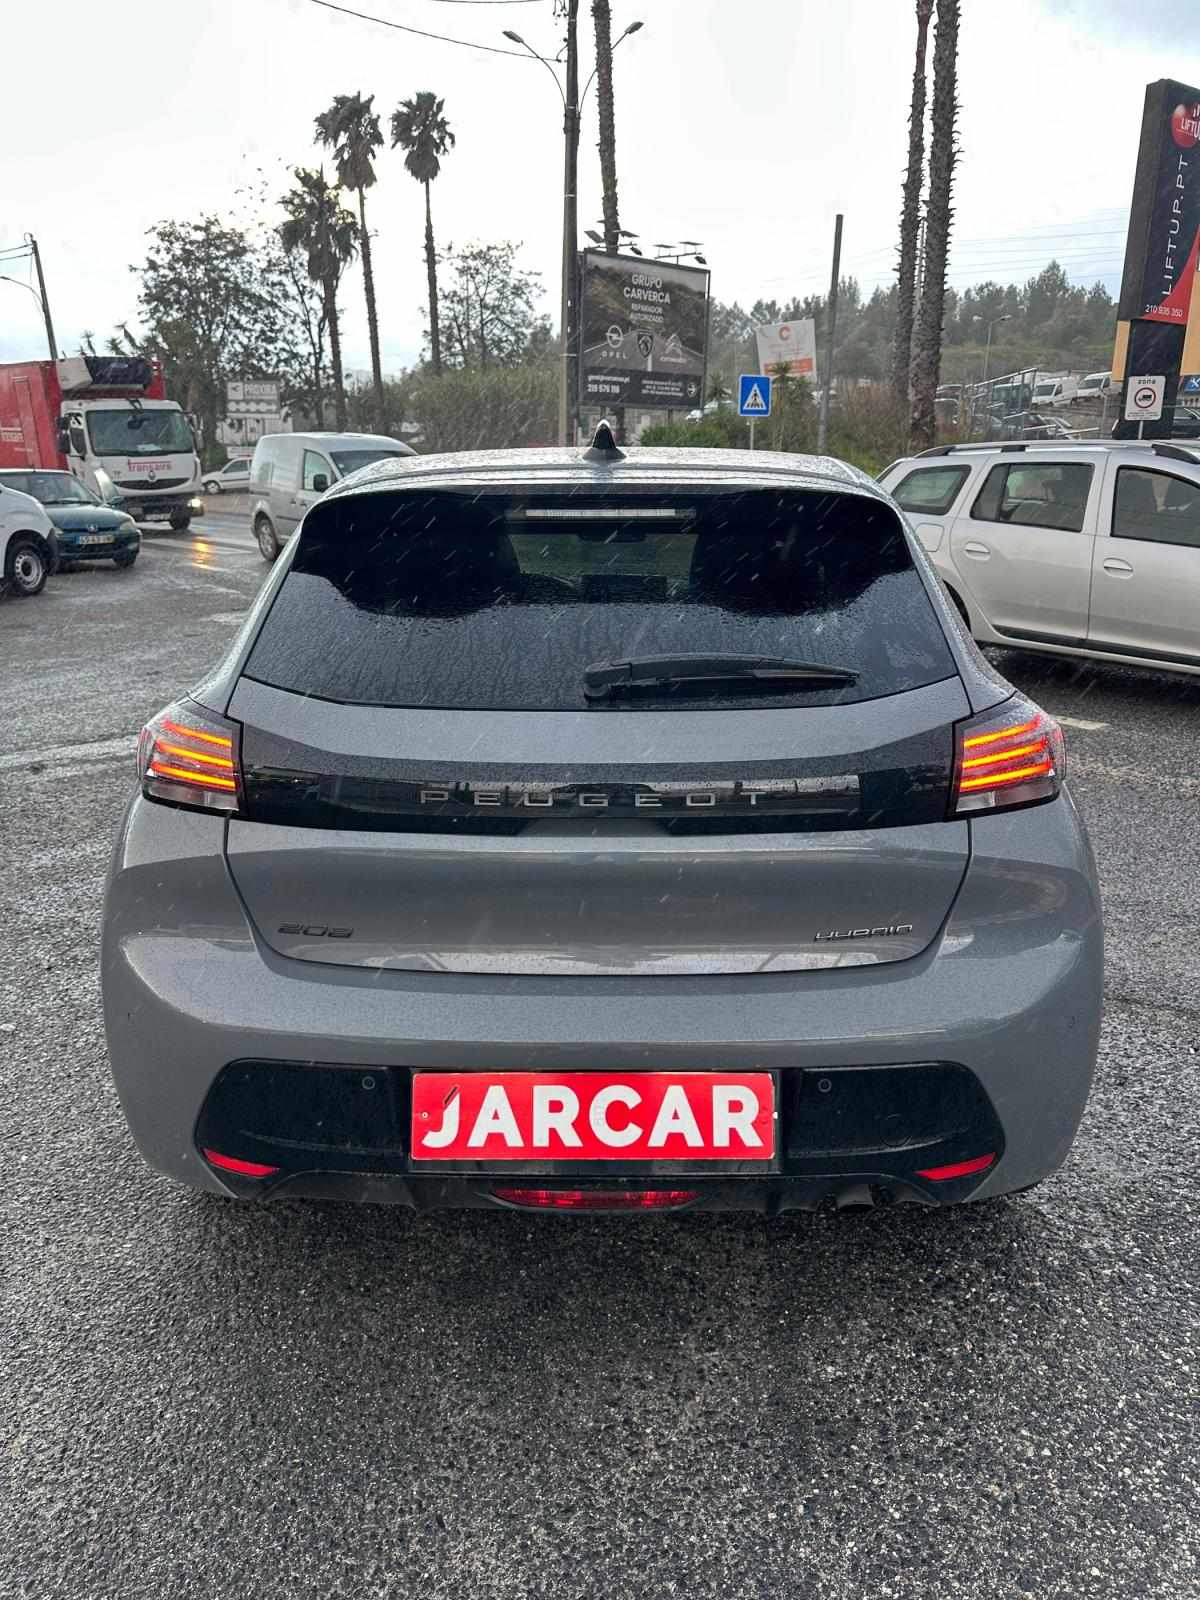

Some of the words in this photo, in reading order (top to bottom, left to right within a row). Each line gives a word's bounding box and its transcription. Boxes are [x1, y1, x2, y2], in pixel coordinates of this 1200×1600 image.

[1181, 117, 1200, 141] LIFTU
[1162, 154, 1188, 295] LIFTUP.PT
[632, 274, 662, 288] GRUPO
[623, 287, 671, 304] CARVERCA
[1145, 304, 1157, 314] 210
[602, 351, 628, 359] OPEL
[420, 791, 766, 808] PEUGEOT
[278, 921, 354, 938] 208
[422, 1085, 764, 1148] JARCAR
